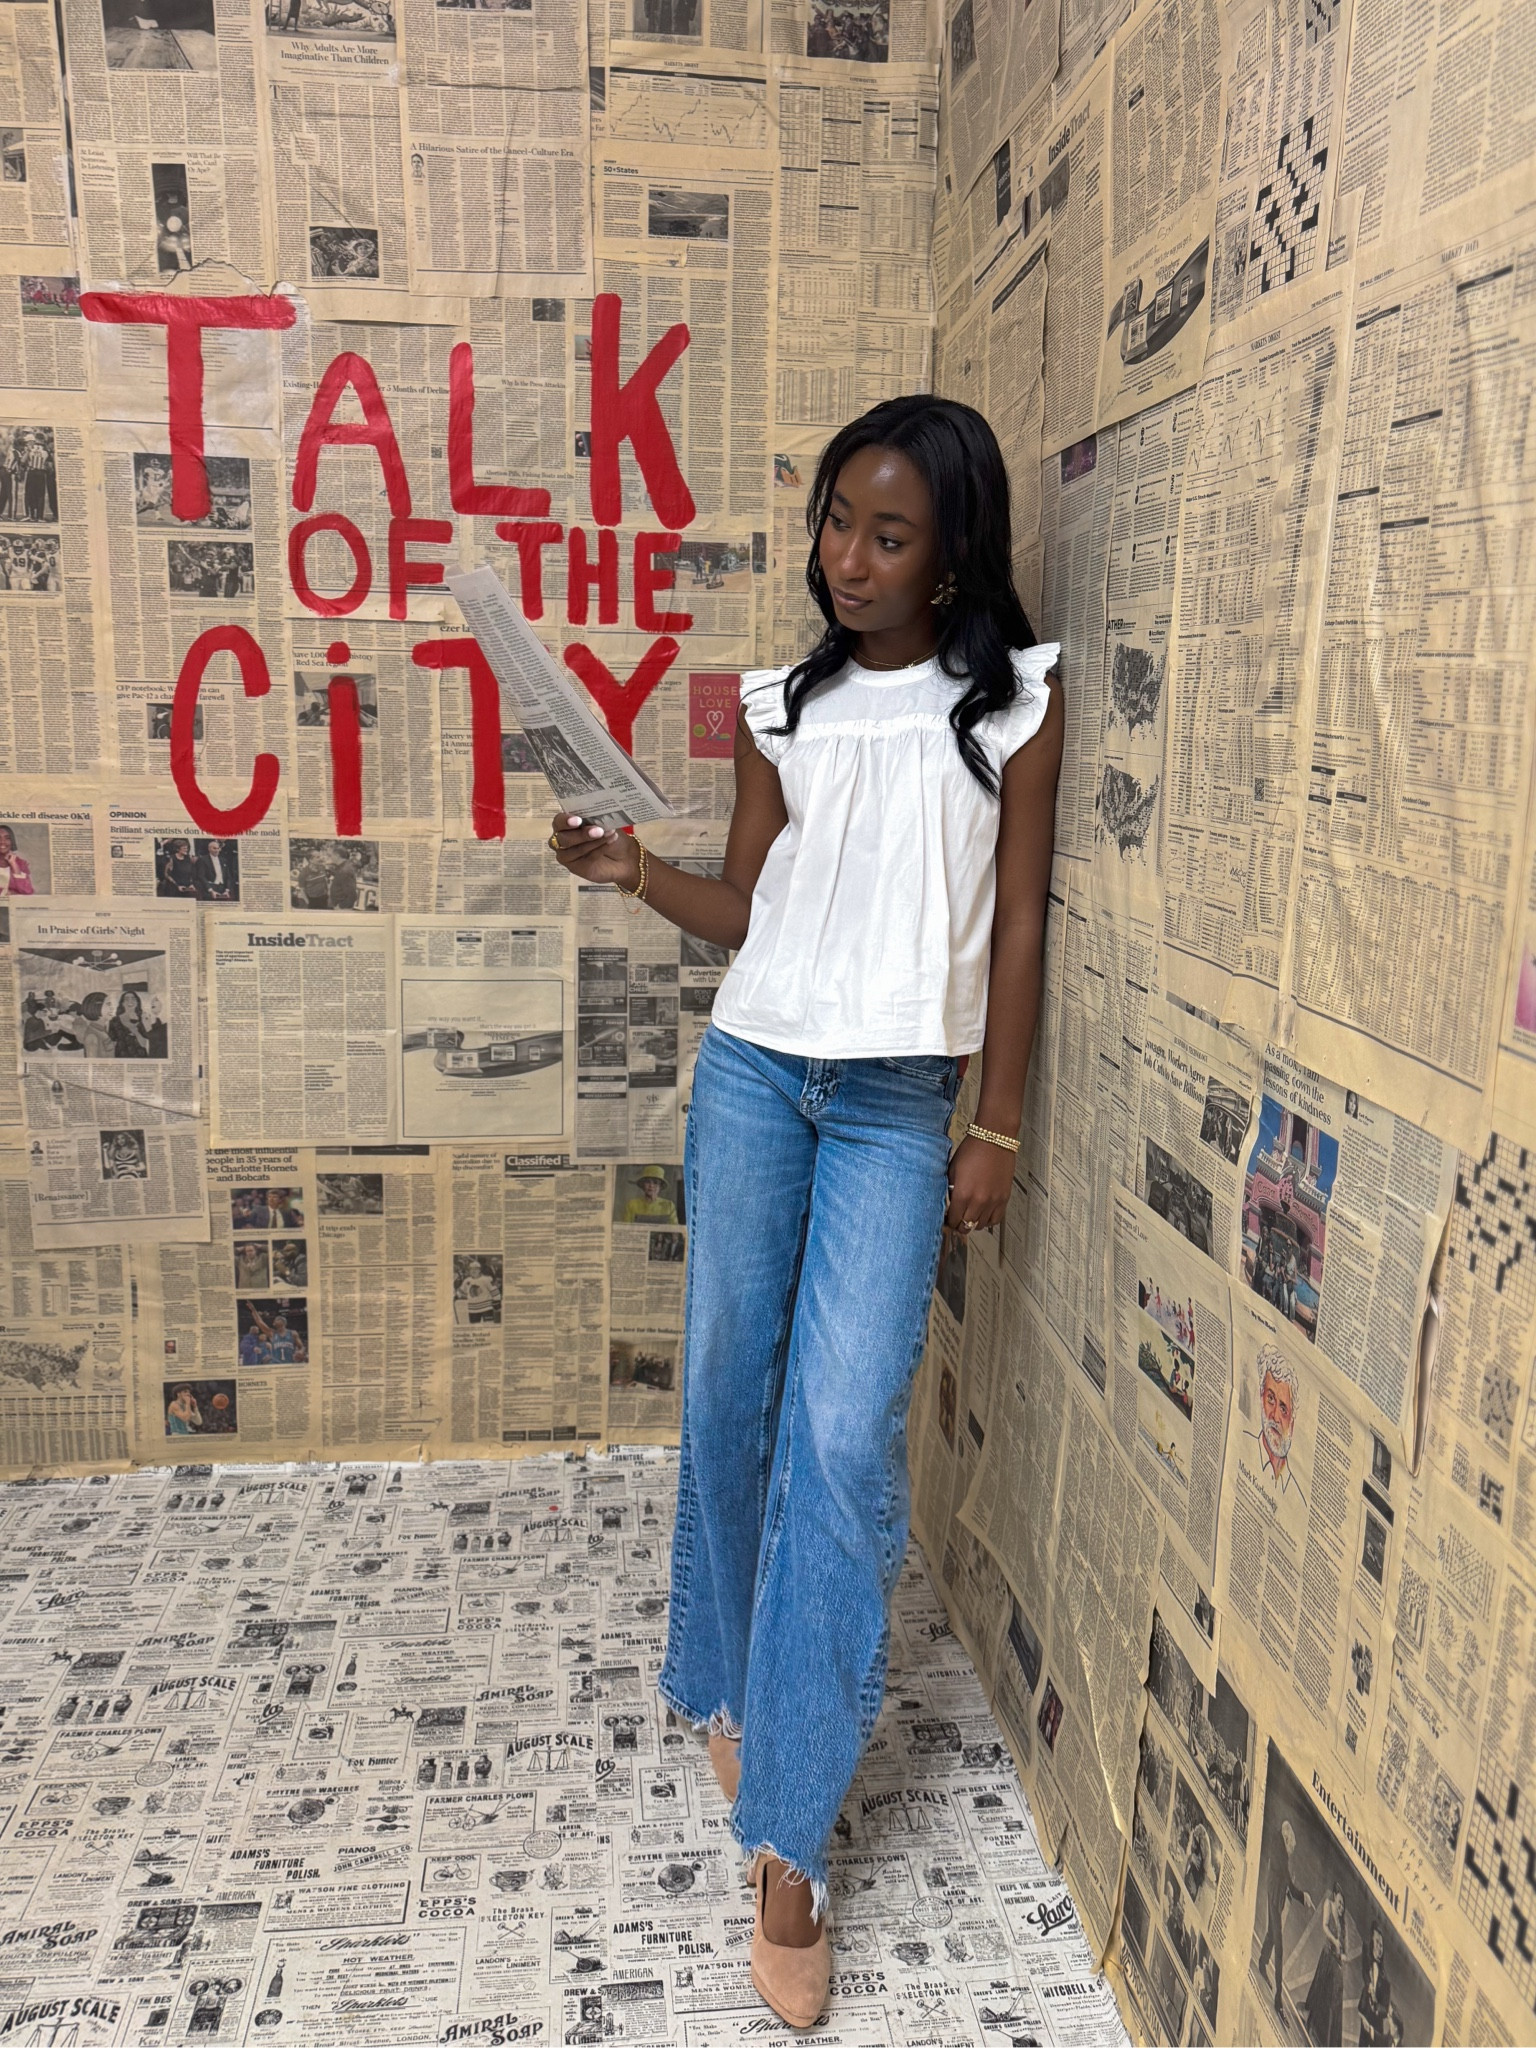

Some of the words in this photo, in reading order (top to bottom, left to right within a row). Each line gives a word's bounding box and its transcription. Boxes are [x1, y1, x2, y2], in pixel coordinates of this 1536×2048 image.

[291, 41, 310, 51] Why
[312, 43, 339, 52] Adults
[340, 44, 356, 54] Are
[357, 45, 378, 54] More
[280, 50, 330, 61] Imaginative
[331, 53, 353, 62] Than
[354, 54, 390, 65] Children
[418, 143, 455, 153] Hilarious
[456, 146, 479, 154] Satire
[480, 146, 489, 154] of
[560, 148, 574, 157] Era
[393, 385, 417, 393] Months
[79, 292, 697, 531] TALK
[287, 513, 453, 620] OF
[495, 521, 694, 634] THE
[130, 685, 166, 693] notebook:
[693, 685, 738, 696] HOUSE
[699, 698, 731, 709] LOVE
[22, 811, 36, 819] cell
[37, 812, 69, 820] disease
[110, 826, 142, 834] Brilliant
[143, 827, 182, 835] scientists
[260, 829, 280, 837] mold
[37, 925, 48, 934] In
[50, 925, 78, 935] Praise
[80, 925, 91, 935] of
[120, 926, 146, 937] Night
[247, 933, 354, 948] InsideTract
[1265, 1042, 1275, 1056] As
[1167, 1049, 1189, 1073] Workers
[1188, 1064, 1205, 1085] Agree
[1170, 1070, 1182, 1088] Save
[1184, 1077, 1205, 1105] Billions
[1264, 1060, 1290, 1085] passing
[1311, 1083, 1324, 1104] the
[1264, 1074, 1288, 1099] lessons
[1289, 1090, 1298, 1105] of
[1298, 1094, 1332, 1126] kindness
[258, 1157, 281, 1165] years
[506, 1155, 561, 1166] Classified
[221, 1164, 262, 1173] Charlotte
[264, 1164, 298, 1172] Hornets
[235, 1173, 271, 1182] Bobcats
[34, 1190, 89, 1202] [Renaissance]
[1239, 1458, 1252, 1482] Mark
[238, 1482, 276, 1496] AUGUST
[278, 1482, 308, 1492] SCALE
[498, 1486, 545, 1499] AMIRAL
[528, 1490, 561, 1500] SOAP
[523, 1520, 558, 1534] AUGUST
[136, 1631, 198, 1648] AMIRAL
[174, 1636, 215, 1648] SOAP
[622, 1637, 662, 1646] FURNITURE
[151, 1678, 196, 1696] AUGUST
[200, 1676, 237, 1690] SCALE
[476, 1684, 535, 1701] AMIRAL
[514, 1690, 554, 1703] SOAP
[134, 1727, 163, 1735] PLOWS
[506, 1735, 552, 1758] AUGUST
[555, 1733, 594, 1750] SCALE
[368, 1757, 398, 1766] Hunter
[861, 1790, 902, 1816] AUGUST
[907, 1790, 950, 1806] SCALE
[702, 1818, 719, 1828] Fox
[14, 1829, 69, 1837] COCOA
[984, 1834, 1022, 1842] PORTRAIT
[1312, 1769, 1400, 1914] Entertainment
[253, 1858, 306, 1869] FURNITURE
[334, 1862, 352, 1872] JOHN
[354, 1851, 390, 1866] CAMPBELL
[836, 1856, 874, 1866] CHARLES
[876, 1854, 906, 1862] PLOWS
[418, 1908, 475, 1918] COCOA
[0, 1921, 76, 1946] AMIRAL
[613, 1921, 654, 1934] ADAMS'S
[43, 1929, 98, 1950] SOAP
[642, 1930, 693, 1945] FURNITURE
[725, 1936, 743, 1946] JOHN
[678, 1943, 714, 1955] POLISH.
[696, 1963, 734, 1971] WATSON
[612, 1967, 654, 1981] AMERICAN
[564, 1988, 588, 1996] DREW
[830, 1984, 888, 1996] COCOA
[944, 1987, 960, 1996] KEY
[1042, 1982, 1086, 1998] MITCHELL
[0, 2000, 71, 2035] AUGUST
[71, 1998, 121, 2023] SCALE
[440, 2013, 518, 2044] AMIRAL
[490, 2022, 544, 2046] SOAP
